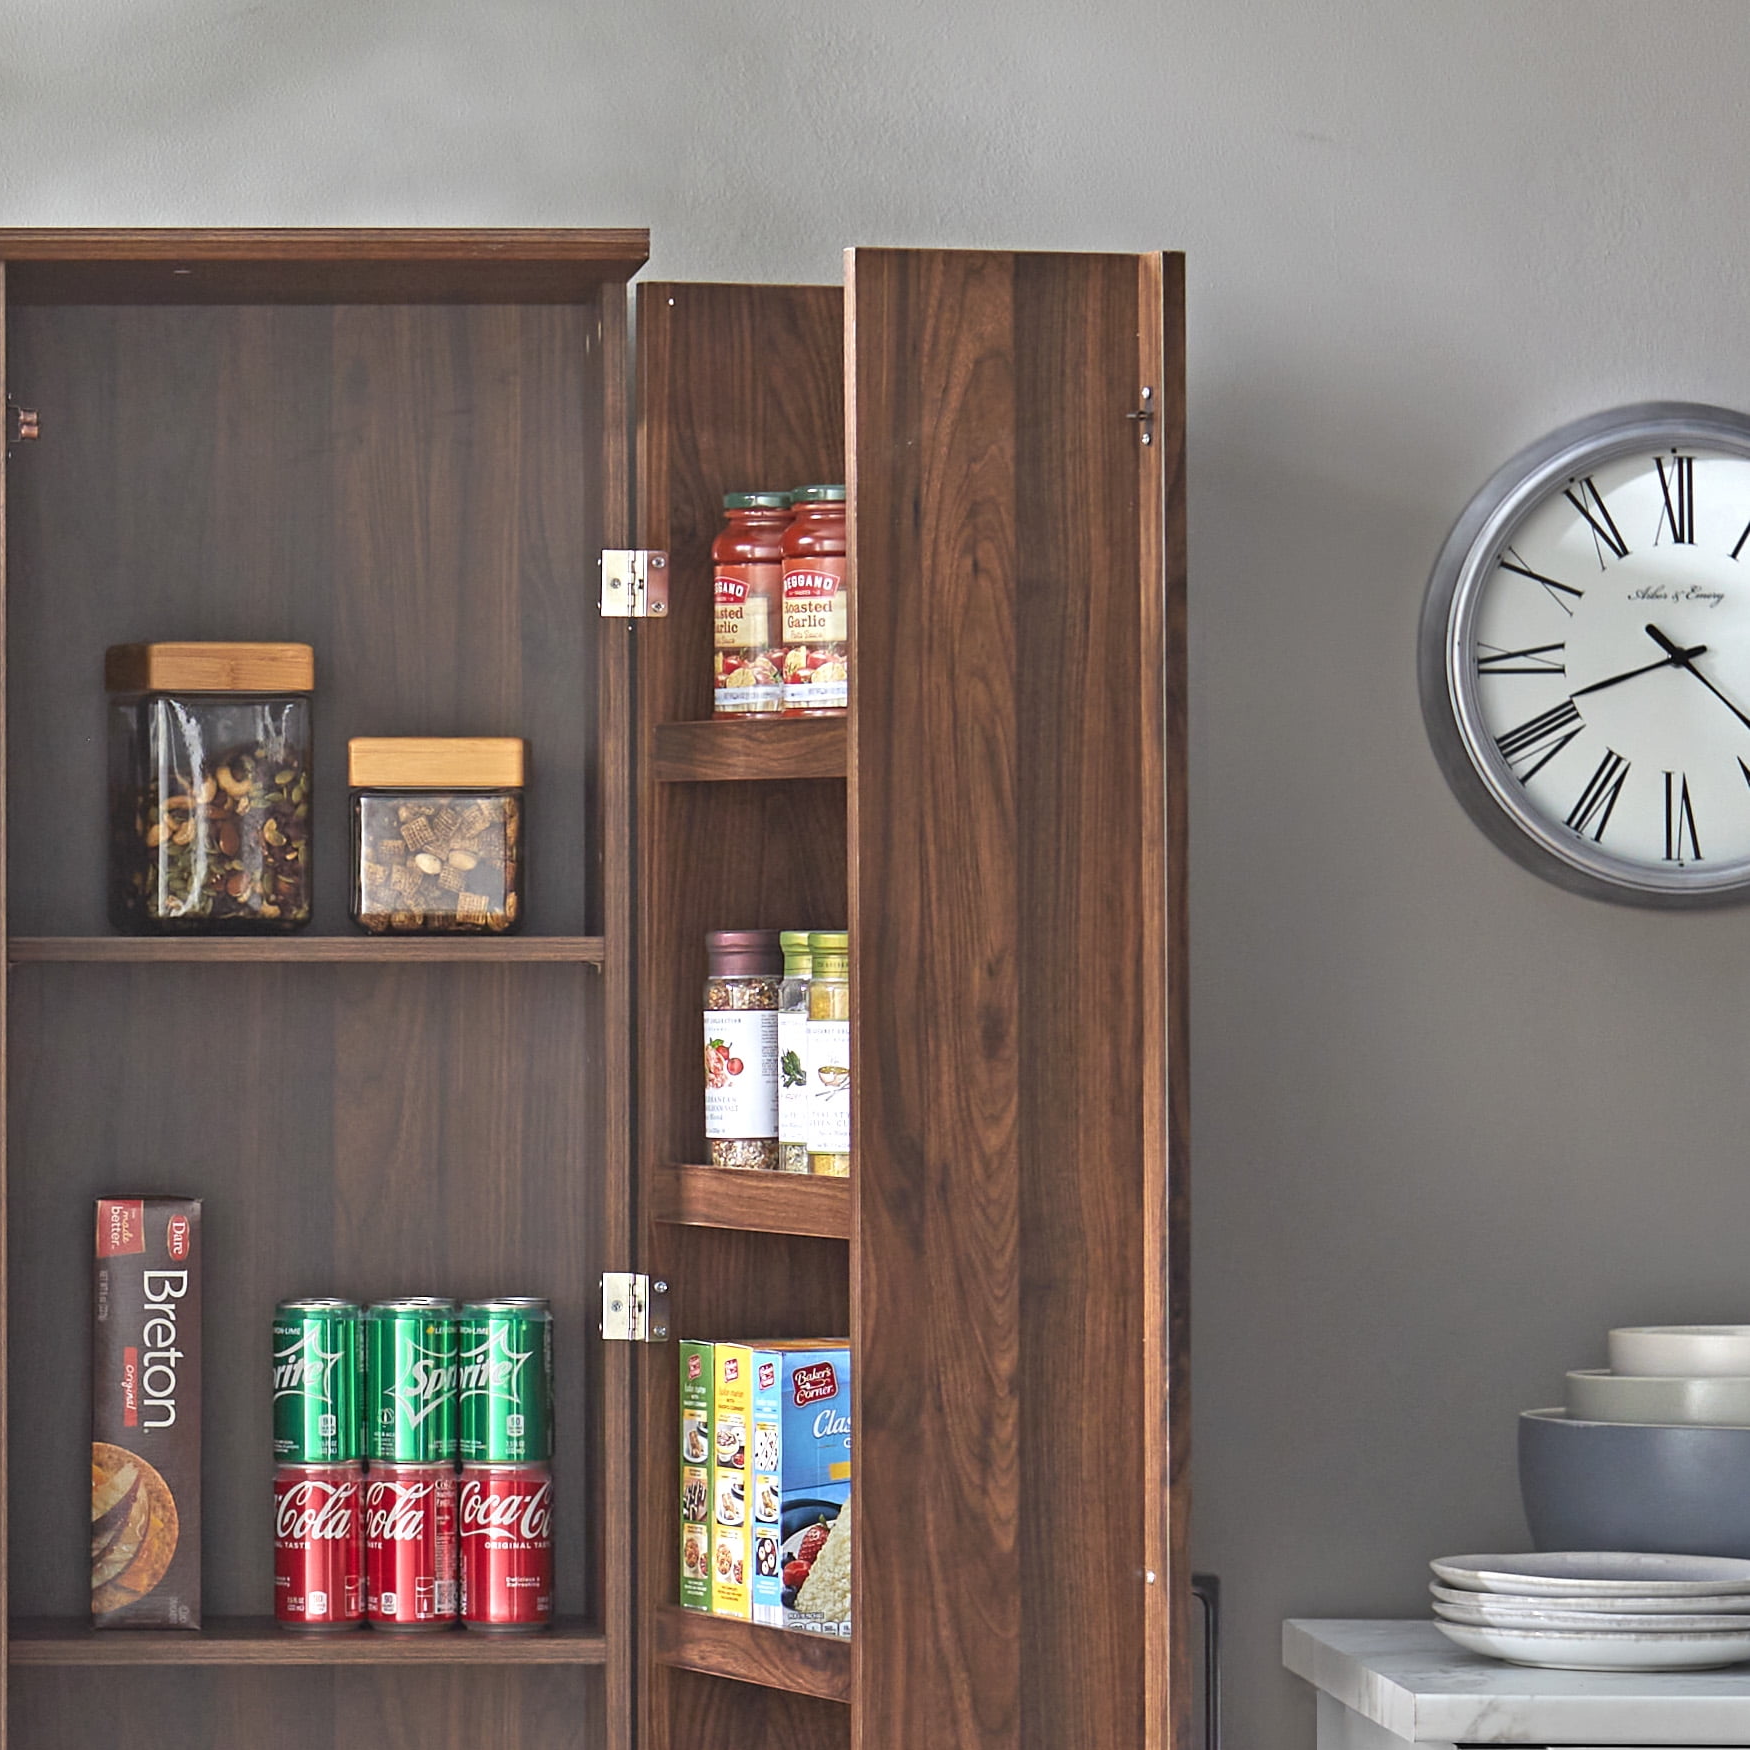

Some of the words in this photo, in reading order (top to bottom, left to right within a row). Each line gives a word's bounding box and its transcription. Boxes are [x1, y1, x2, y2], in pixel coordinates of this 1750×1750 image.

[787, 616, 826, 628] Garlic
[111, 1206, 123, 1247] better
[172, 1222, 185, 1255] Dare
[143, 1270, 188, 1428] Breton
[795, 1367, 831, 1386] Baker's
[485, 1541, 531, 1549] ORIGINAL
